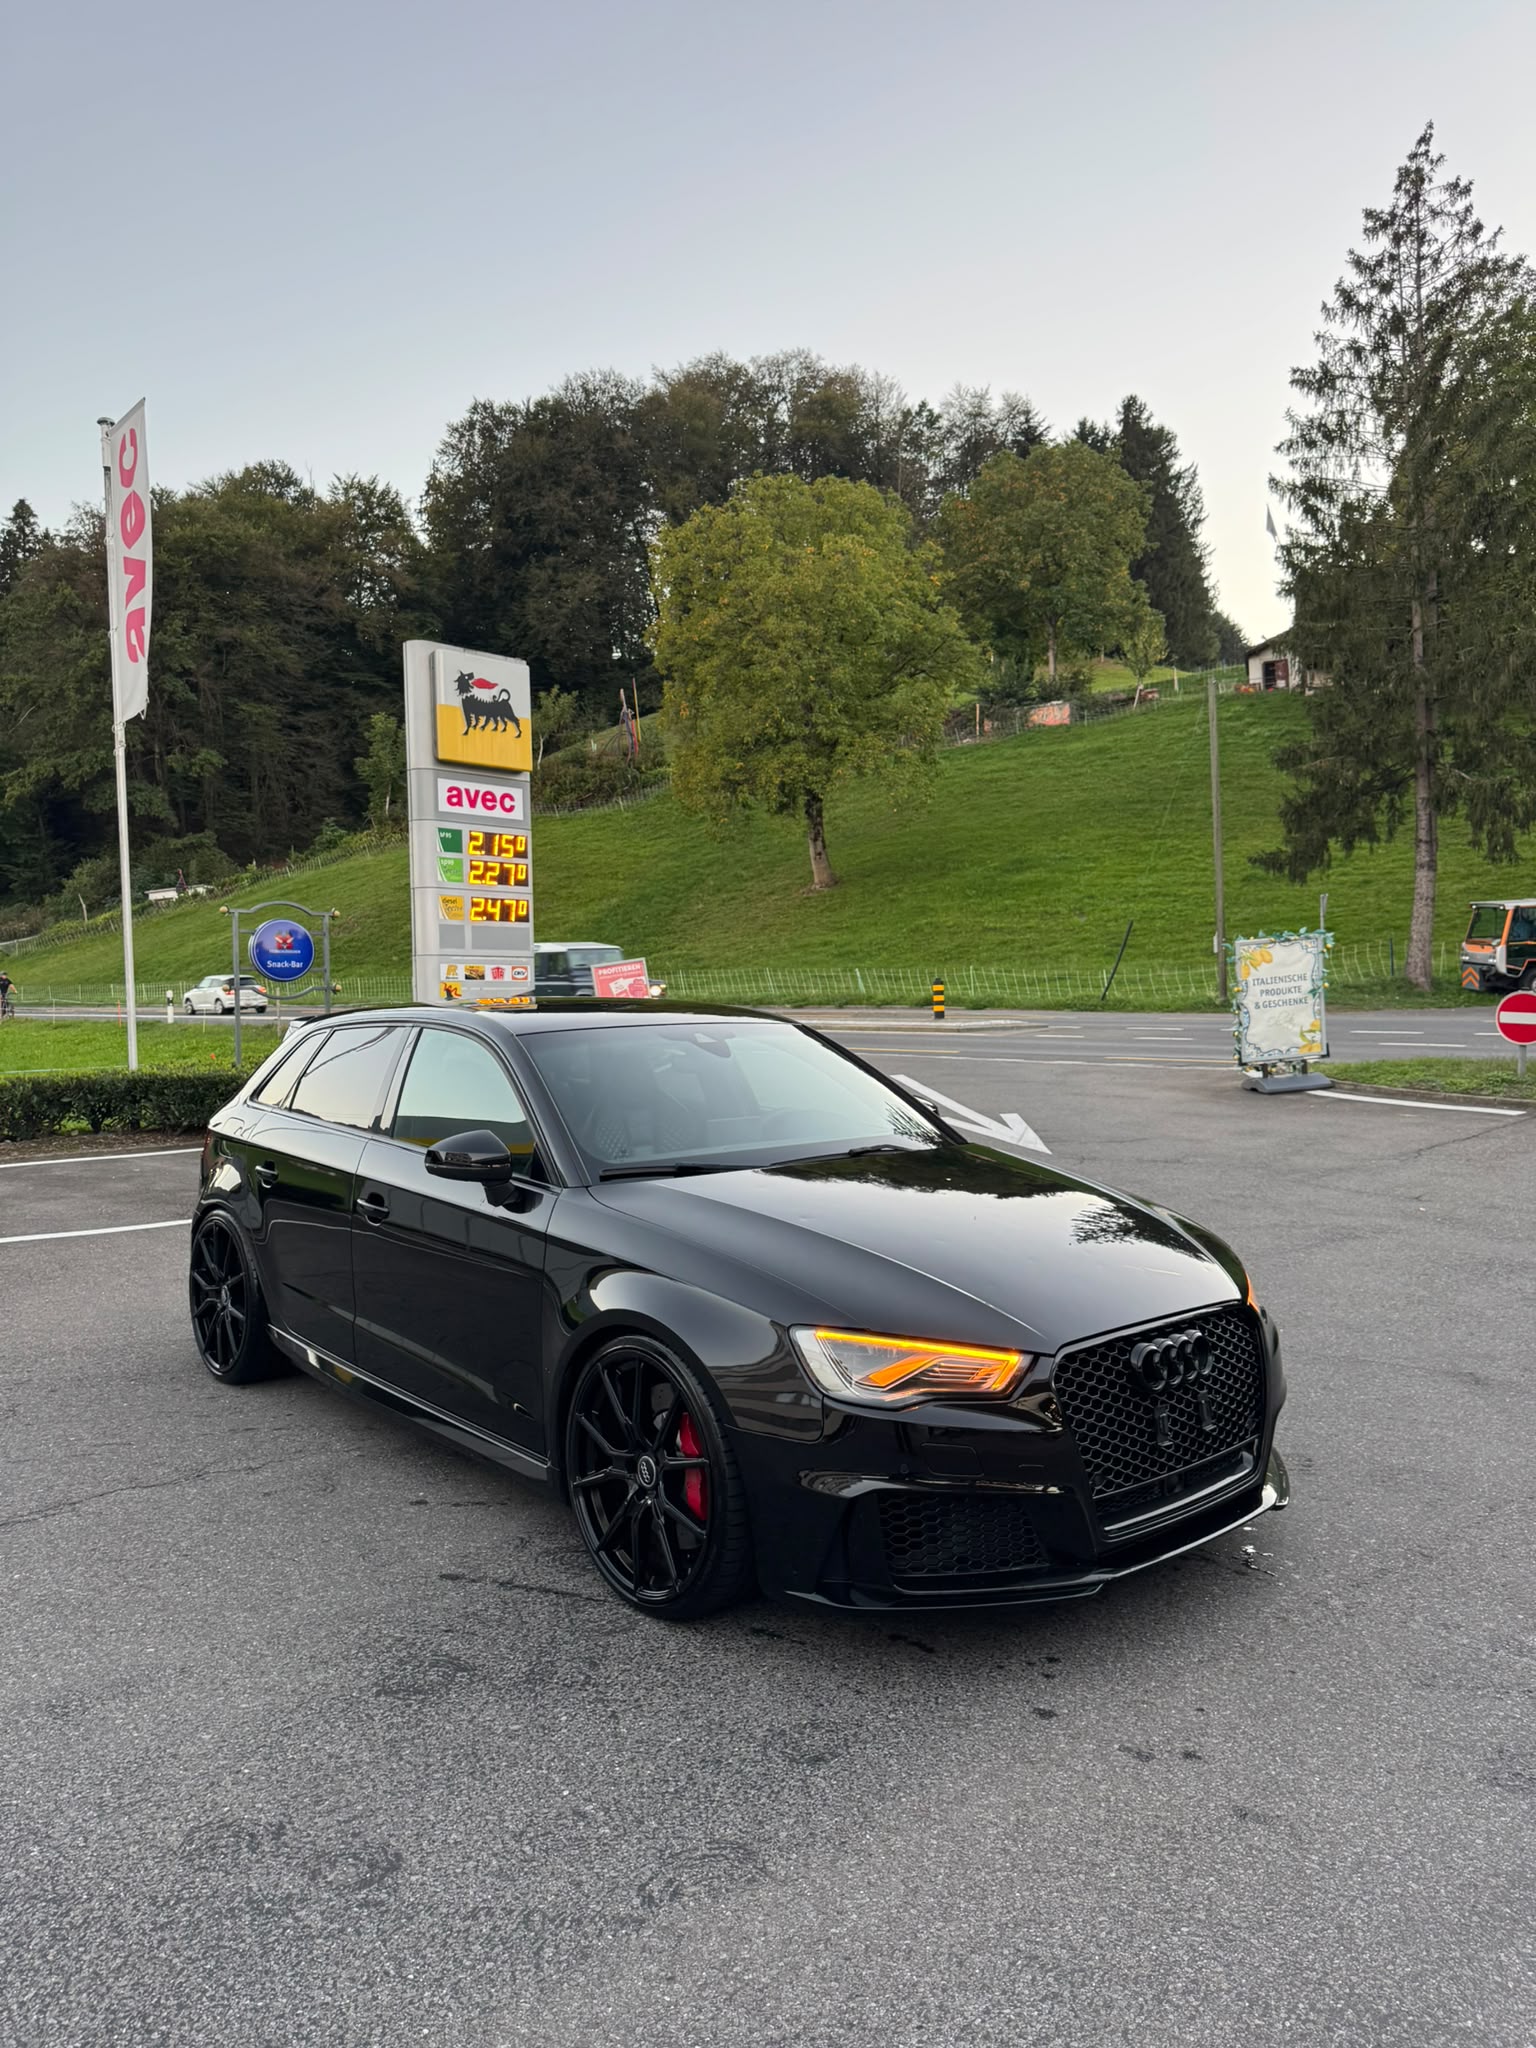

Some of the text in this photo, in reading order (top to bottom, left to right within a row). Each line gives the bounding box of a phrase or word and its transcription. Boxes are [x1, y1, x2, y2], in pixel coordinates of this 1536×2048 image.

[118, 428, 146, 663] avec
[446, 786, 516, 813] avec
[468, 831, 526, 858] 2.150
[469, 860, 527, 886] 2.270
[470, 897, 528, 922] 2.470
[266, 960, 304, 968] Snack-Bar
[1252, 973, 1308, 986] ITALIENISCHE
[1260, 986, 1302, 997] PRODUKTE
[1262, 996, 1309, 1009] GESCHENKE
